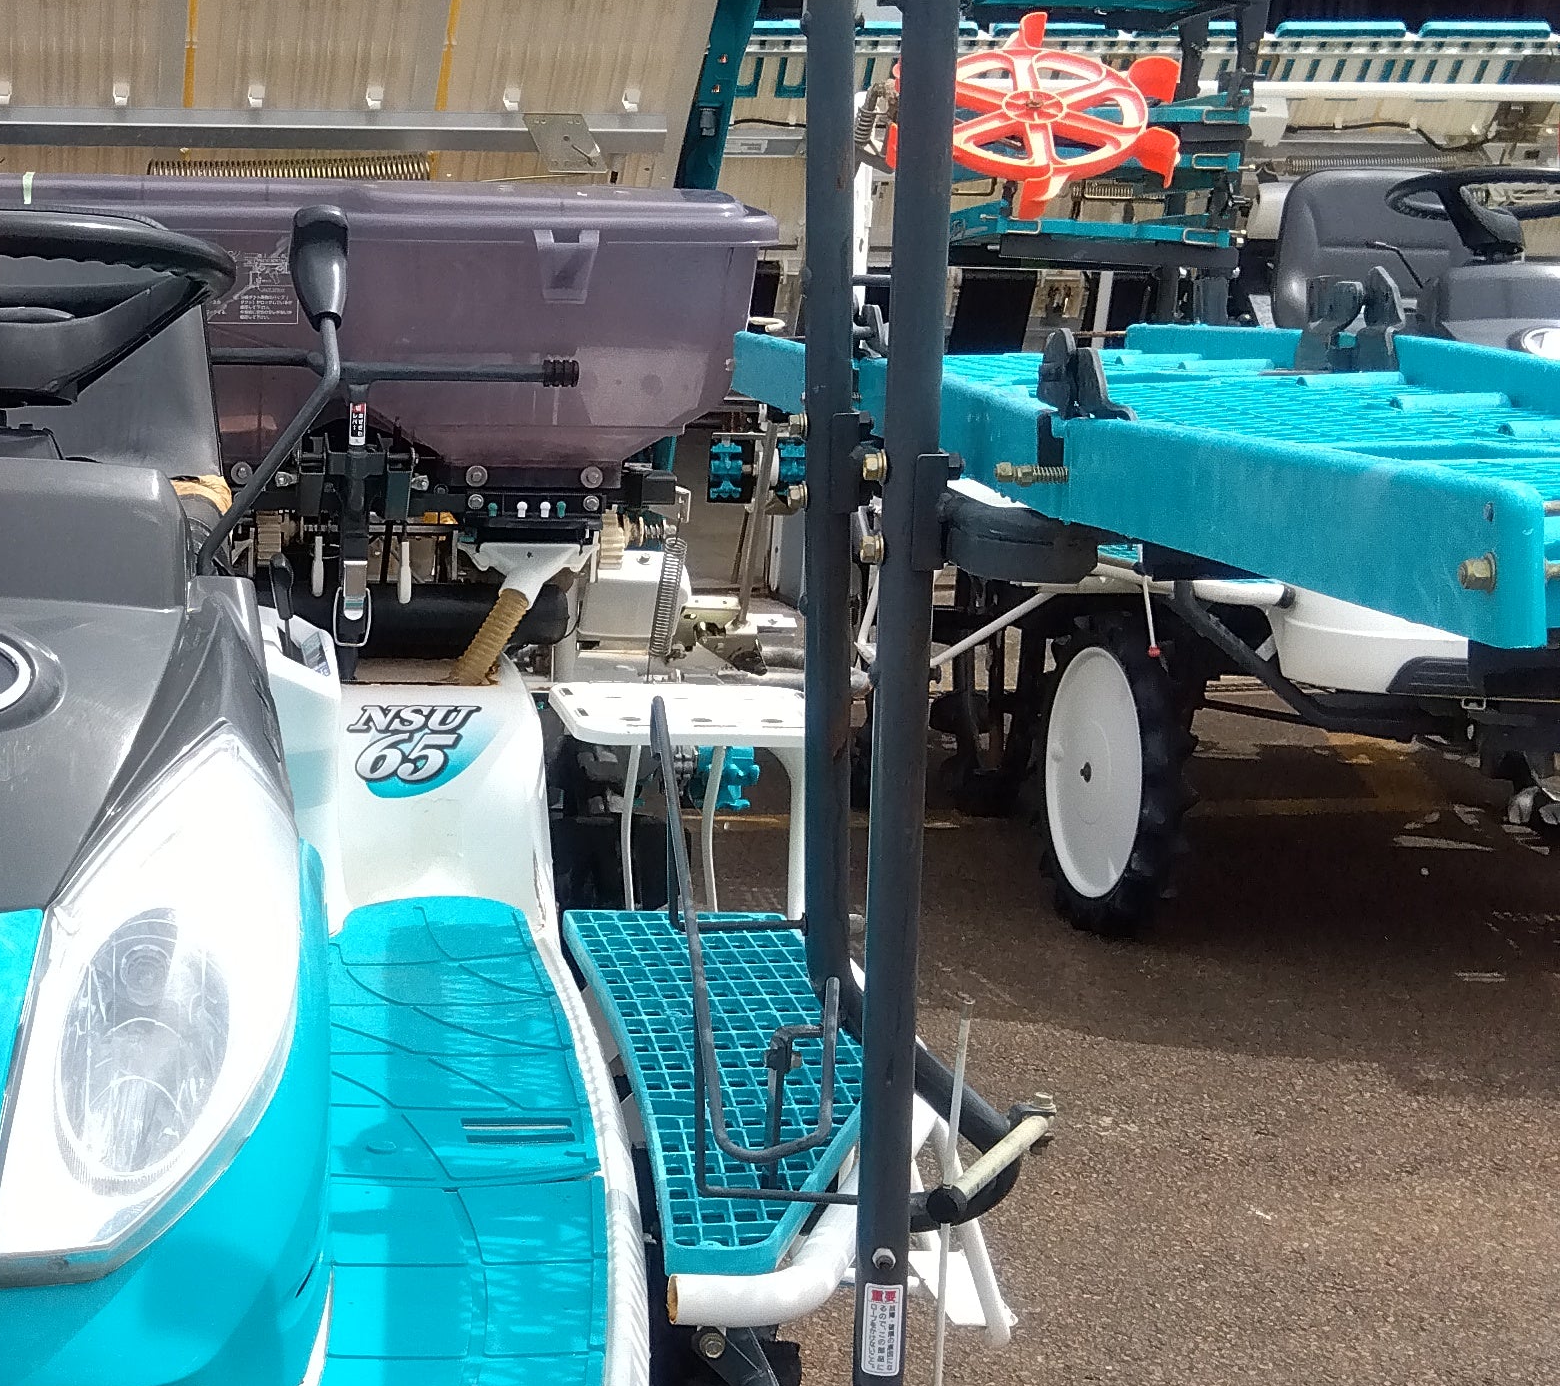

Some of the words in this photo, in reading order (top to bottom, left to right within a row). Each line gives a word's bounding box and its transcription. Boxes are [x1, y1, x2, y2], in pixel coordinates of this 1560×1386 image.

[347, 704, 483, 733] NSU
[355, 733, 464, 782] 65
[871, 1290, 897, 1303] 重要
